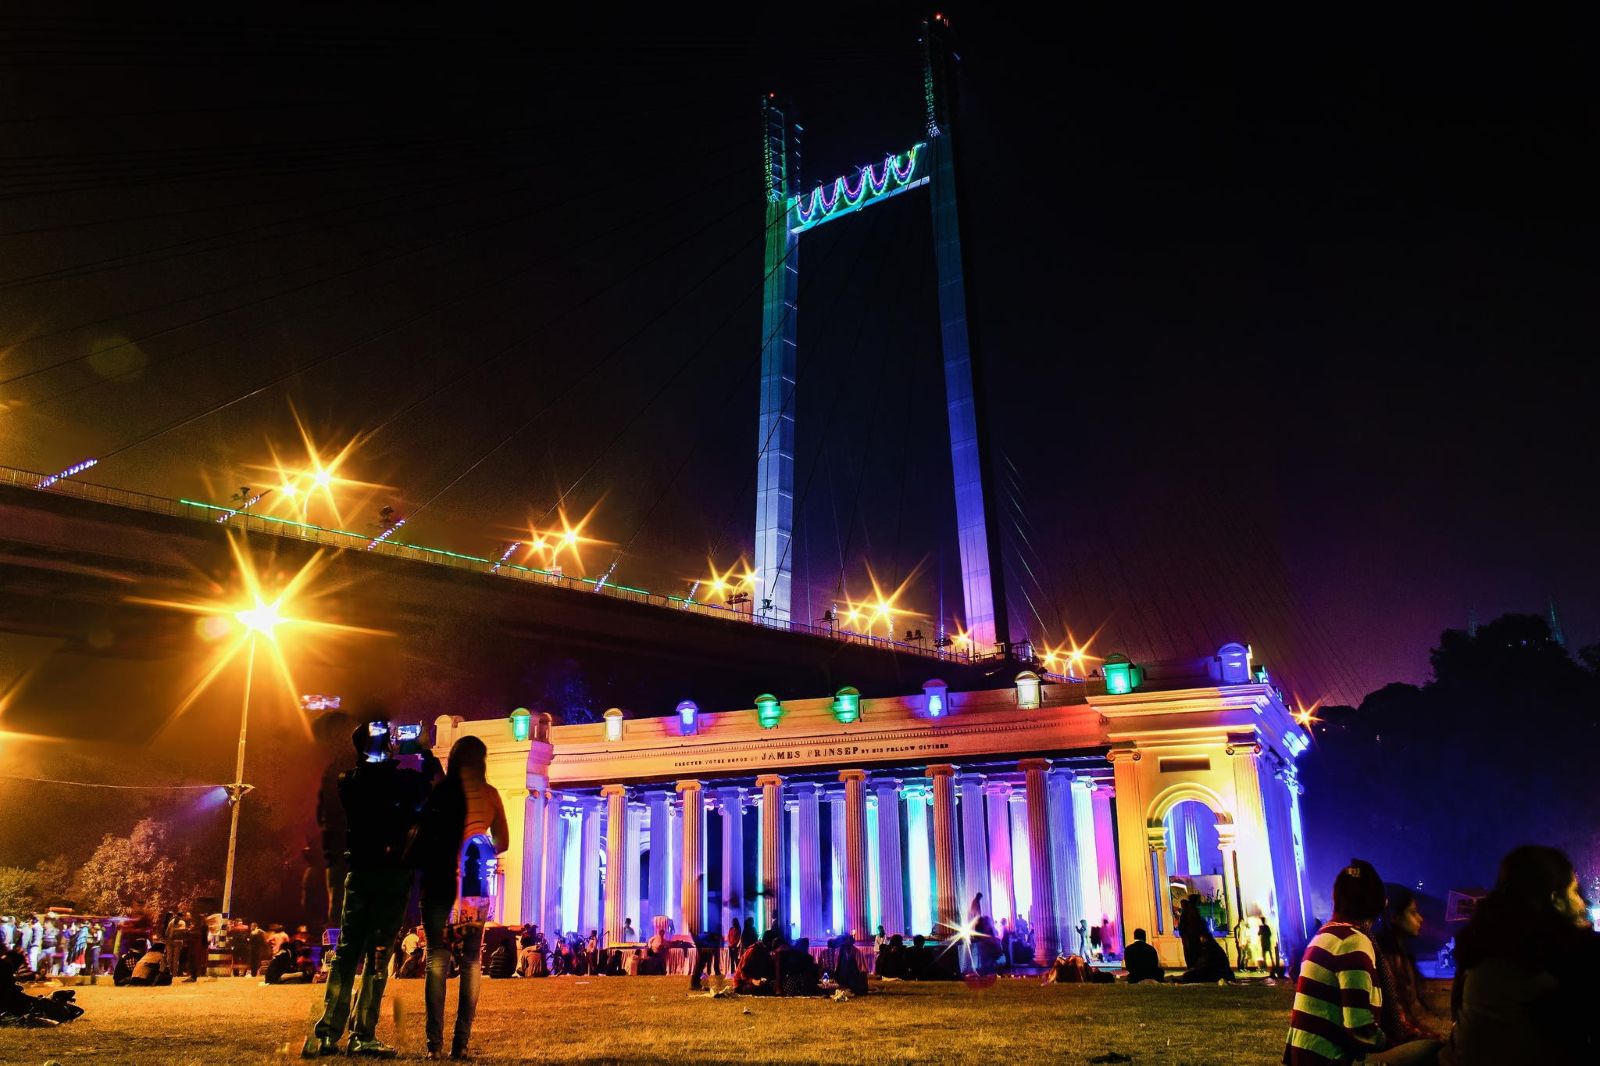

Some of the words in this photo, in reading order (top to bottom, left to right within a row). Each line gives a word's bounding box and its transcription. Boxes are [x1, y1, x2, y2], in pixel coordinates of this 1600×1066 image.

[761, 751, 801, 760] JAMES
[807, 746, 859, 757] PRINSEP
[886, 745, 916, 753] FELLOW
